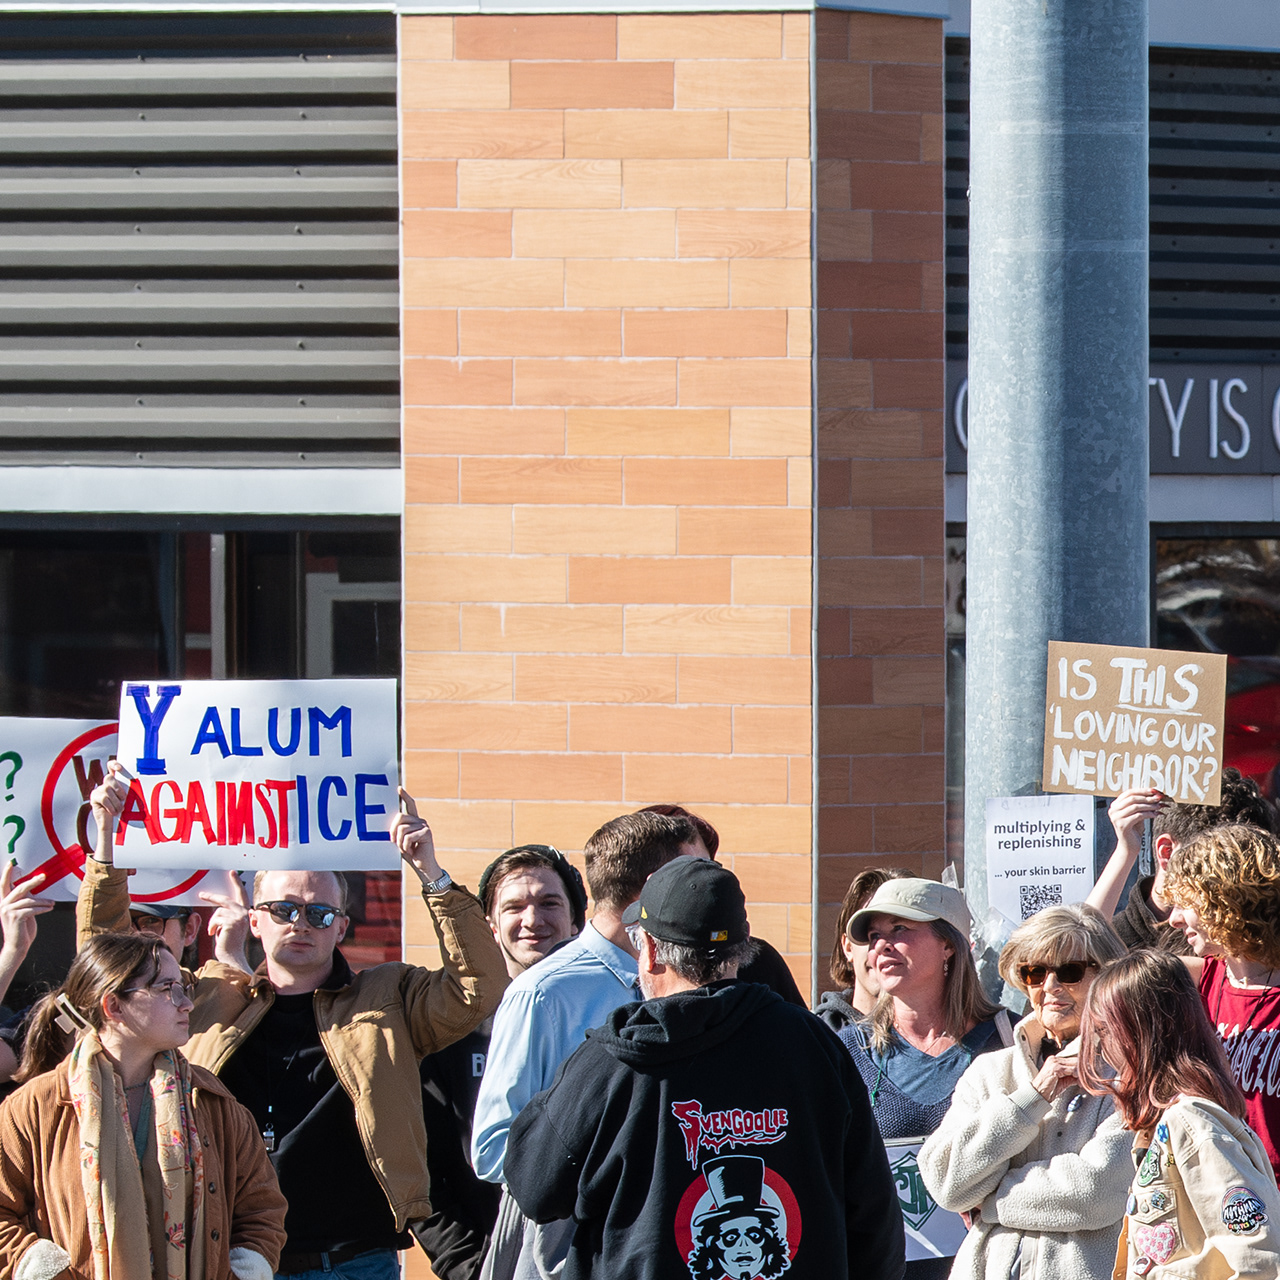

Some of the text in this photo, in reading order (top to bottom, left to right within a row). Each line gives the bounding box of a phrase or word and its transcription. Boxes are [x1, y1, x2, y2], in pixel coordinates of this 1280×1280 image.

[1209, 379, 1250, 459] IS
[1058, 657, 1204, 712] IS THIS
[126, 683, 352, 775] Y ALUM
[1162, 718, 1217, 753] OUR
[115, 776, 297, 849] AGAINST
[297, 773, 391, 845] ICE
[994, 819, 1086, 837] multiplying &
[998, 835, 1082, 851] replenishing
[1005, 867, 1027, 879] your
[1030, 866, 1050, 876] skin
[1052, 865, 1087, 876] barrier
[671, 1099, 789, 1170] SVENGOOLIE
